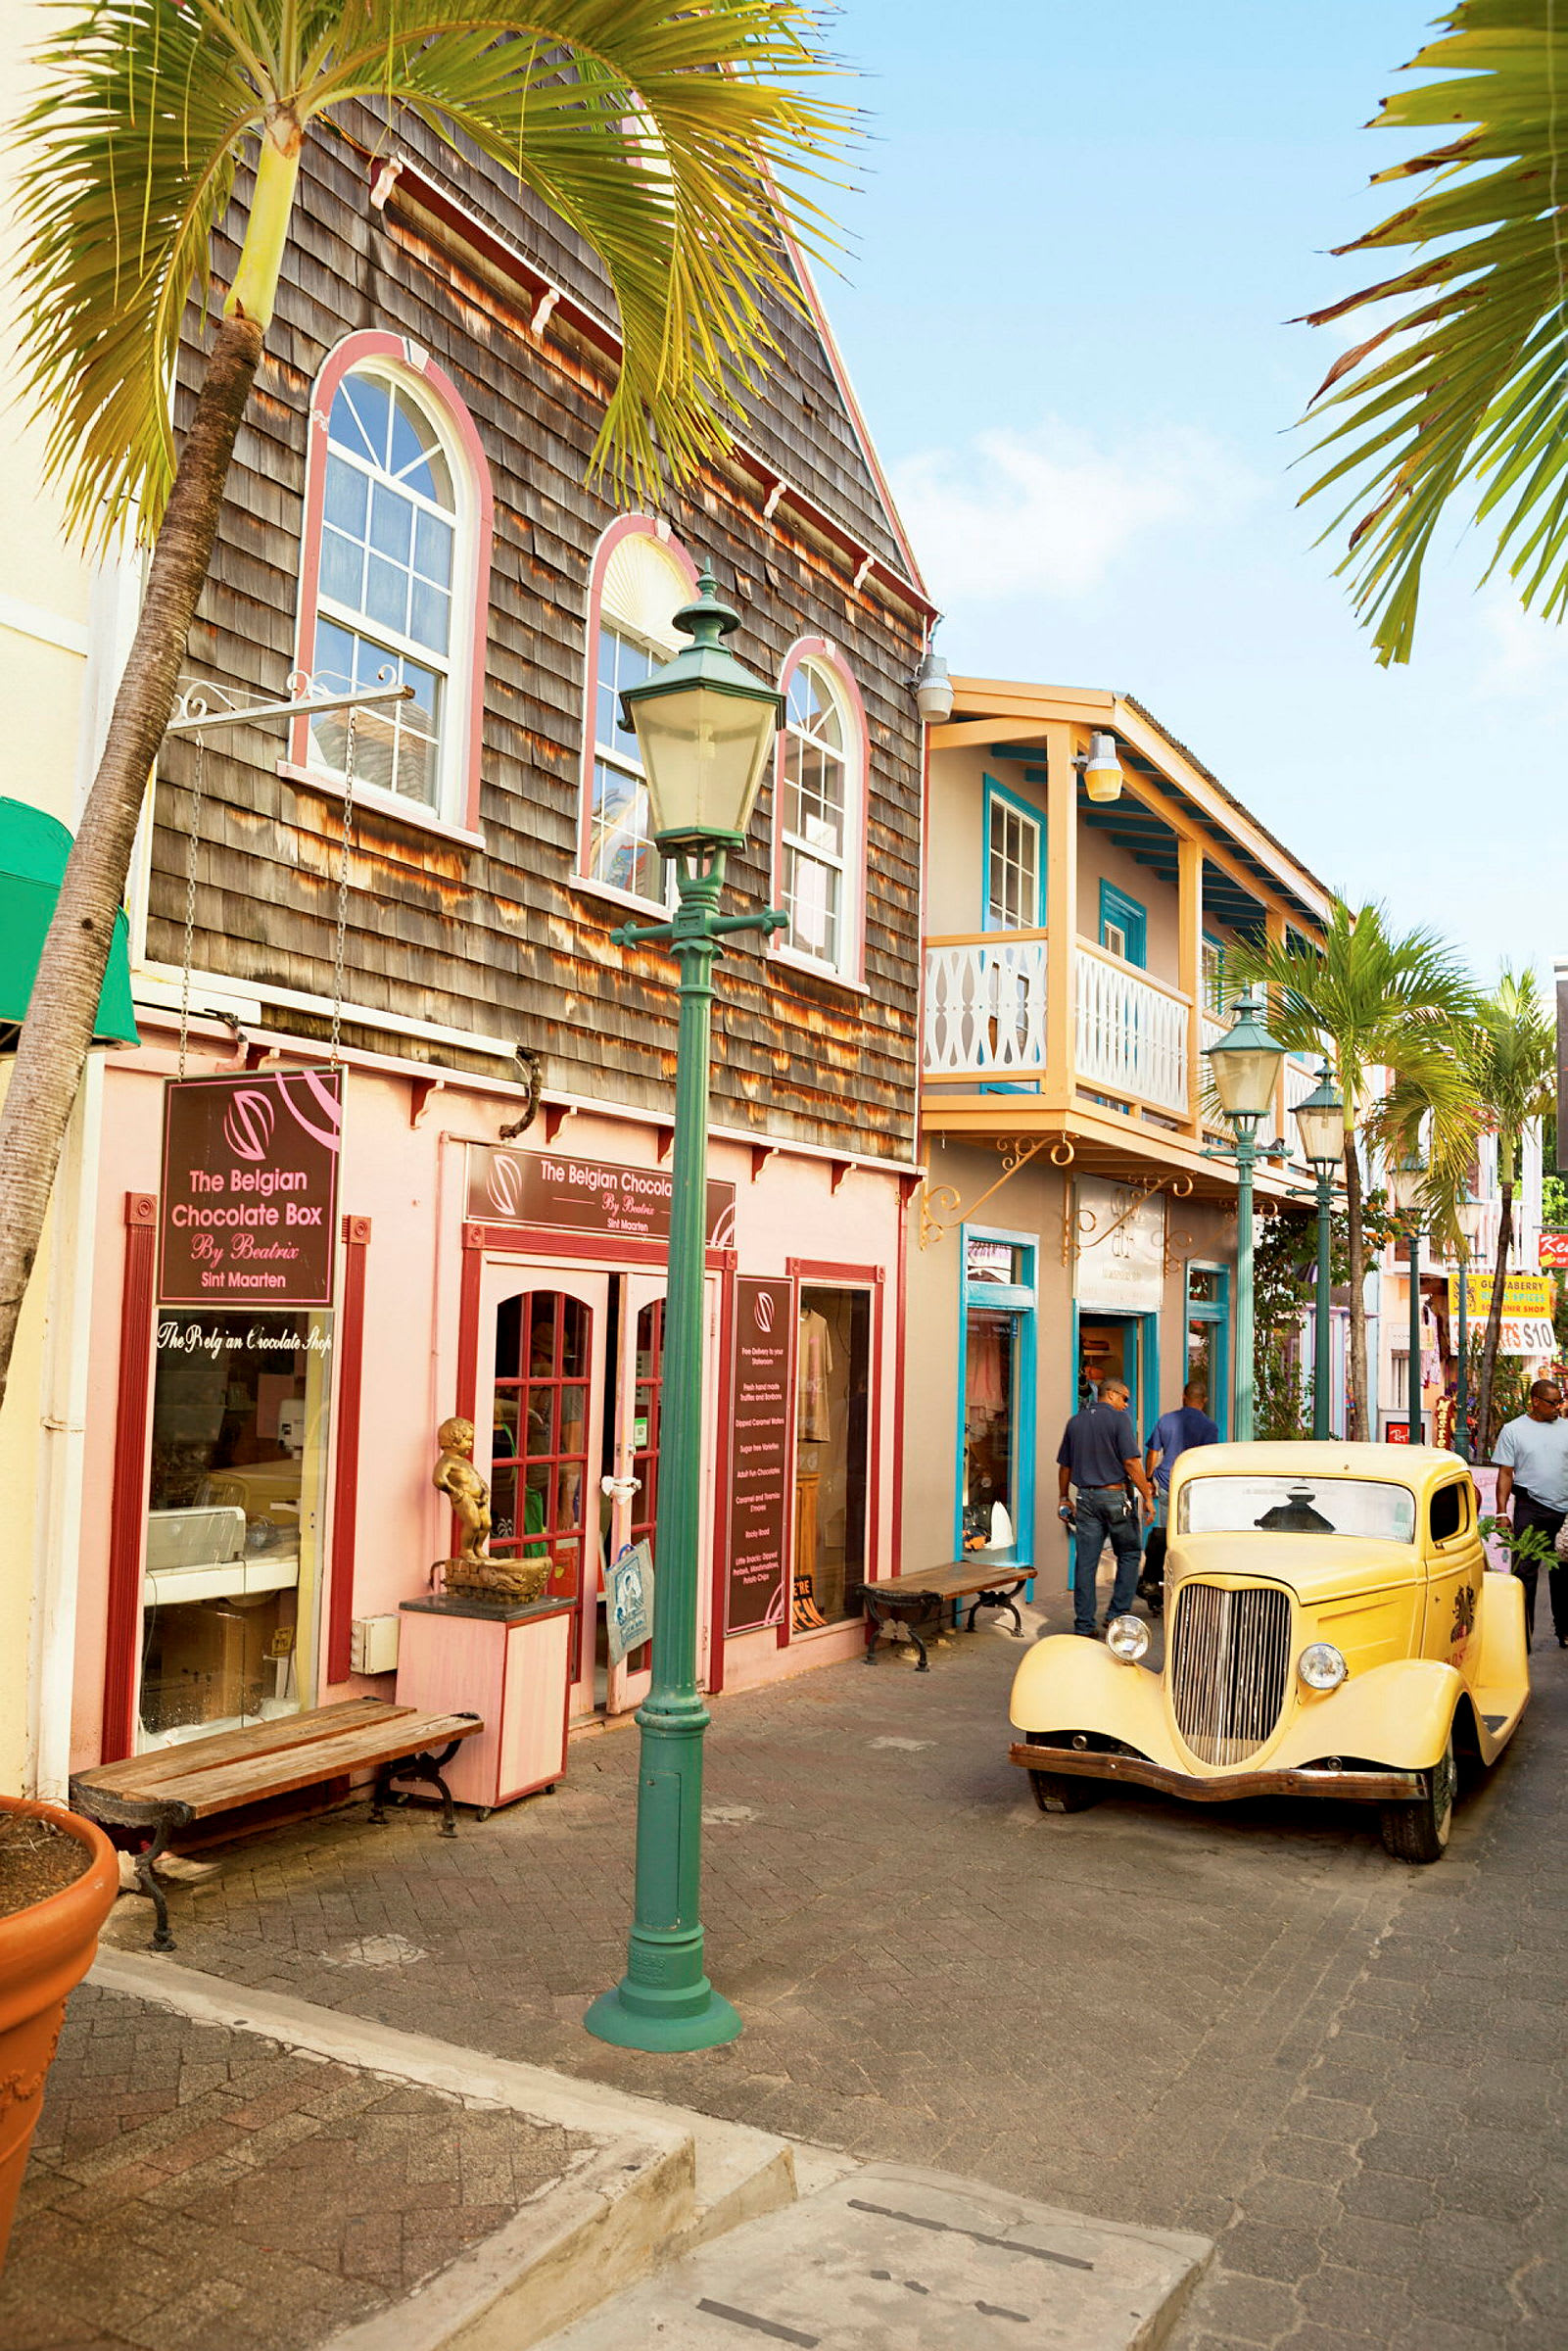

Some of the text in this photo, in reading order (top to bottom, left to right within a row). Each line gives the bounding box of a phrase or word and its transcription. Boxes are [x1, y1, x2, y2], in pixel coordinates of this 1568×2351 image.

[189, 1168, 308, 1196] The Belgian
[541, 1160, 673, 1197] The Belgian Chocola
[171, 1202, 322, 1227] Chocolate Box
[602, 1191, 619, 1217] By
[606, 1218, 648, 1232] Sint Maarten
[190, 1232, 300, 1269] By Beatrix
[1541, 1235, 1568, 1253] Ke
[201, 1271, 286, 1288] Sint Maarten
[1481, 1280, 1544, 1291] GUABERRY
[1482, 1304, 1521, 1313] SOENIR
[157, 1320, 185, 1349] The
[185, 1323, 244, 1360] Belgan
[302, 1324, 333, 1359] Shop
[792, 1579, 810, 1597] E'RE
[791, 1597, 829, 1631] PEN
